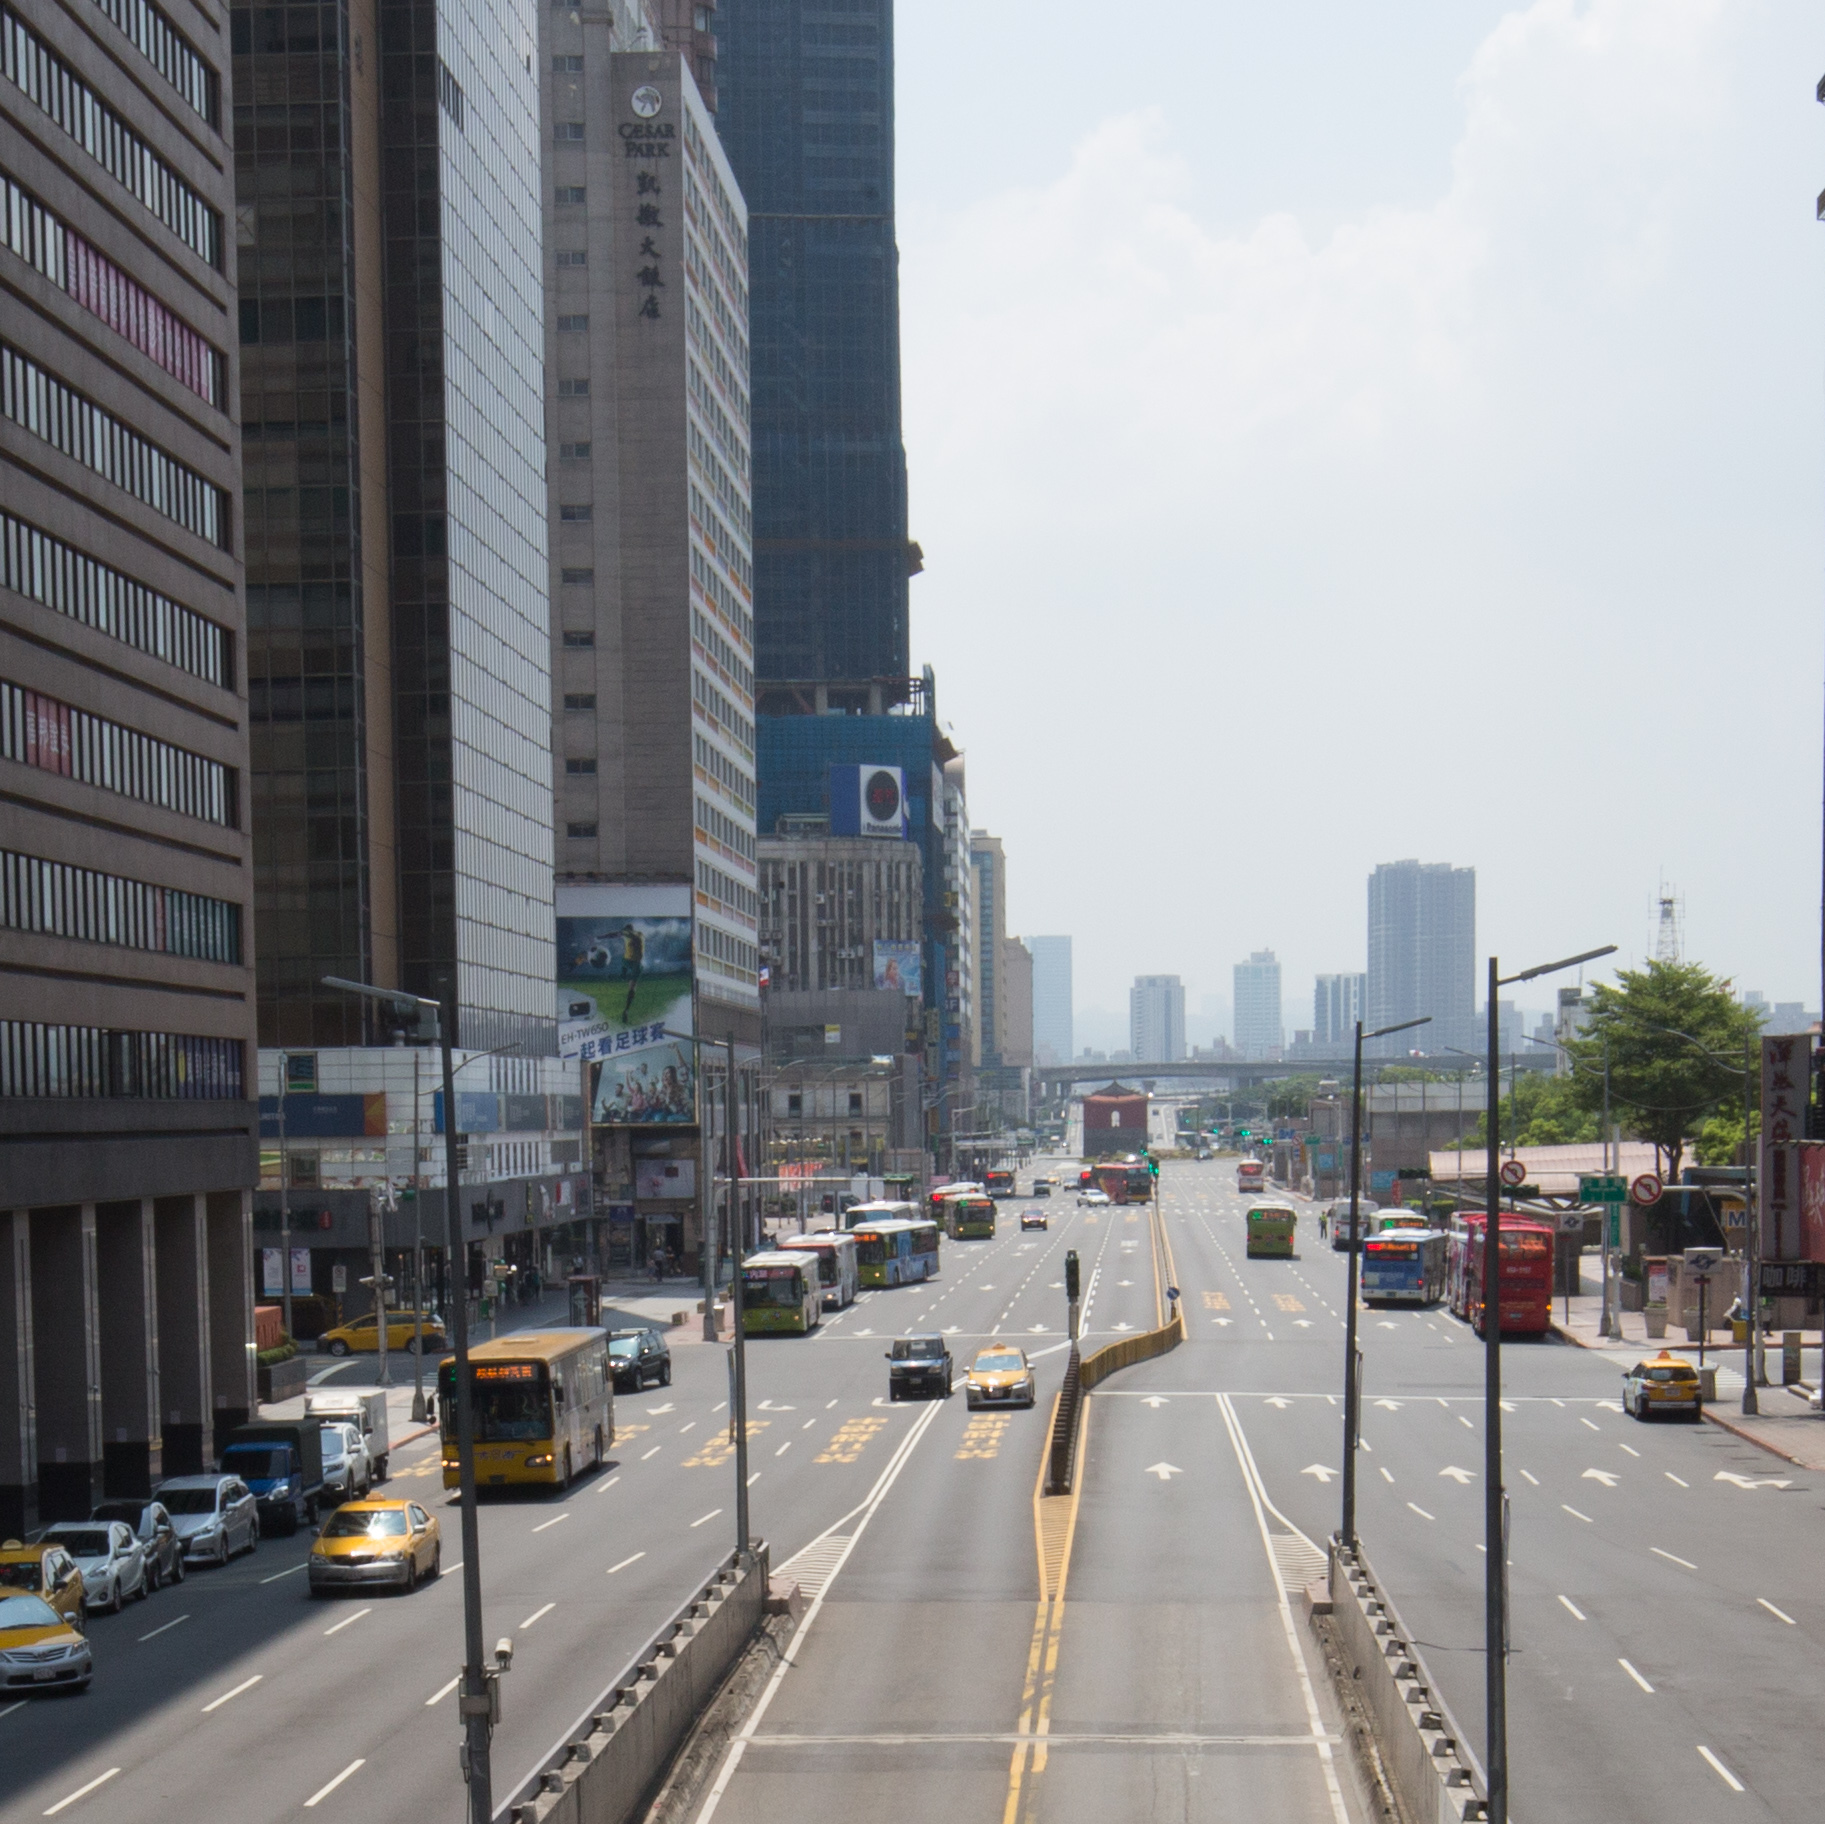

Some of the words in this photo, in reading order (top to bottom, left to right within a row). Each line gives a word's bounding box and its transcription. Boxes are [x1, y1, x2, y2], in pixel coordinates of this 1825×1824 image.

[625, 141, 671, 158] PARK
[563, 1021, 666, 1060] 一起看足球賽
[1760, 1264, 1808, 1290] 咖啡
